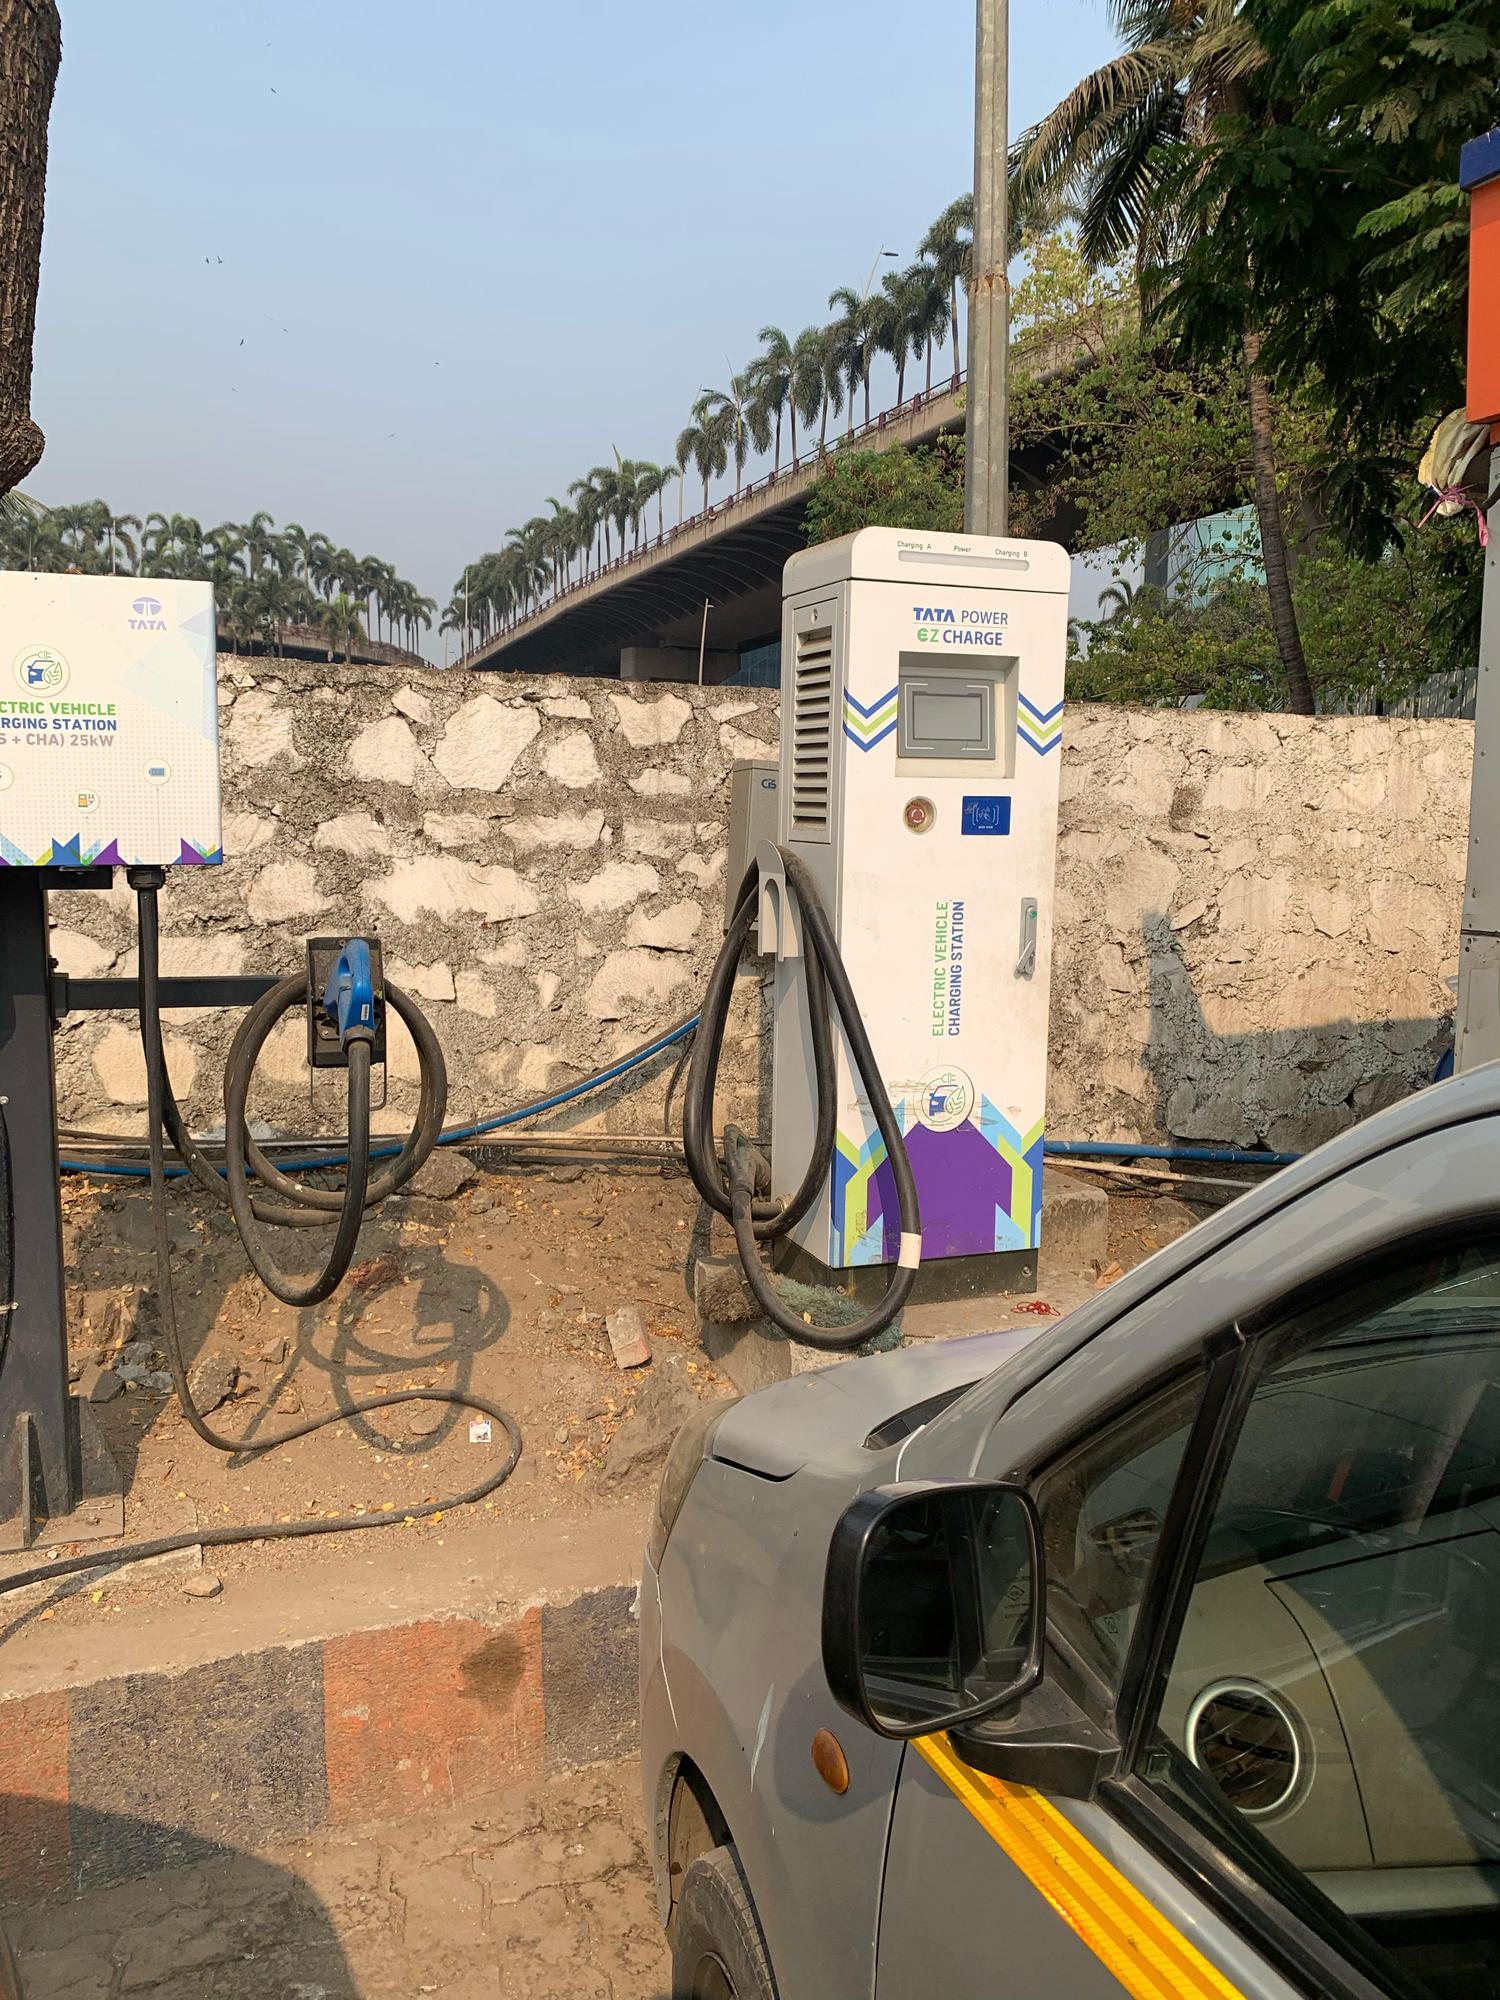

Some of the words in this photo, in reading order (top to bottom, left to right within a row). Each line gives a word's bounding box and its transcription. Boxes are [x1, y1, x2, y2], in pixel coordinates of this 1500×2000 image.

[897, 540, 924, 550] Charging
[953, 545, 972, 553] Power
[995, 548, 1020, 558] Charging
[913, 607, 956, 623] TATA
[961, 610, 1008, 625] POWER
[128, 619, 167, 631] TATA
[942, 629, 1003, 646] CHARGE
[49, 702, 117, 716] VEHICLE
[52, 718, 117, 731] STATION
[26, 733, 65, 748] CHA)
[70, 734, 114, 747] 25kW
[934, 901, 949, 964] VEHICLE
[950, 901, 965, 961] STATION
[932, 967, 946, 1037] ELECTRIC
[948, 964, 962, 1036] CHARGING
